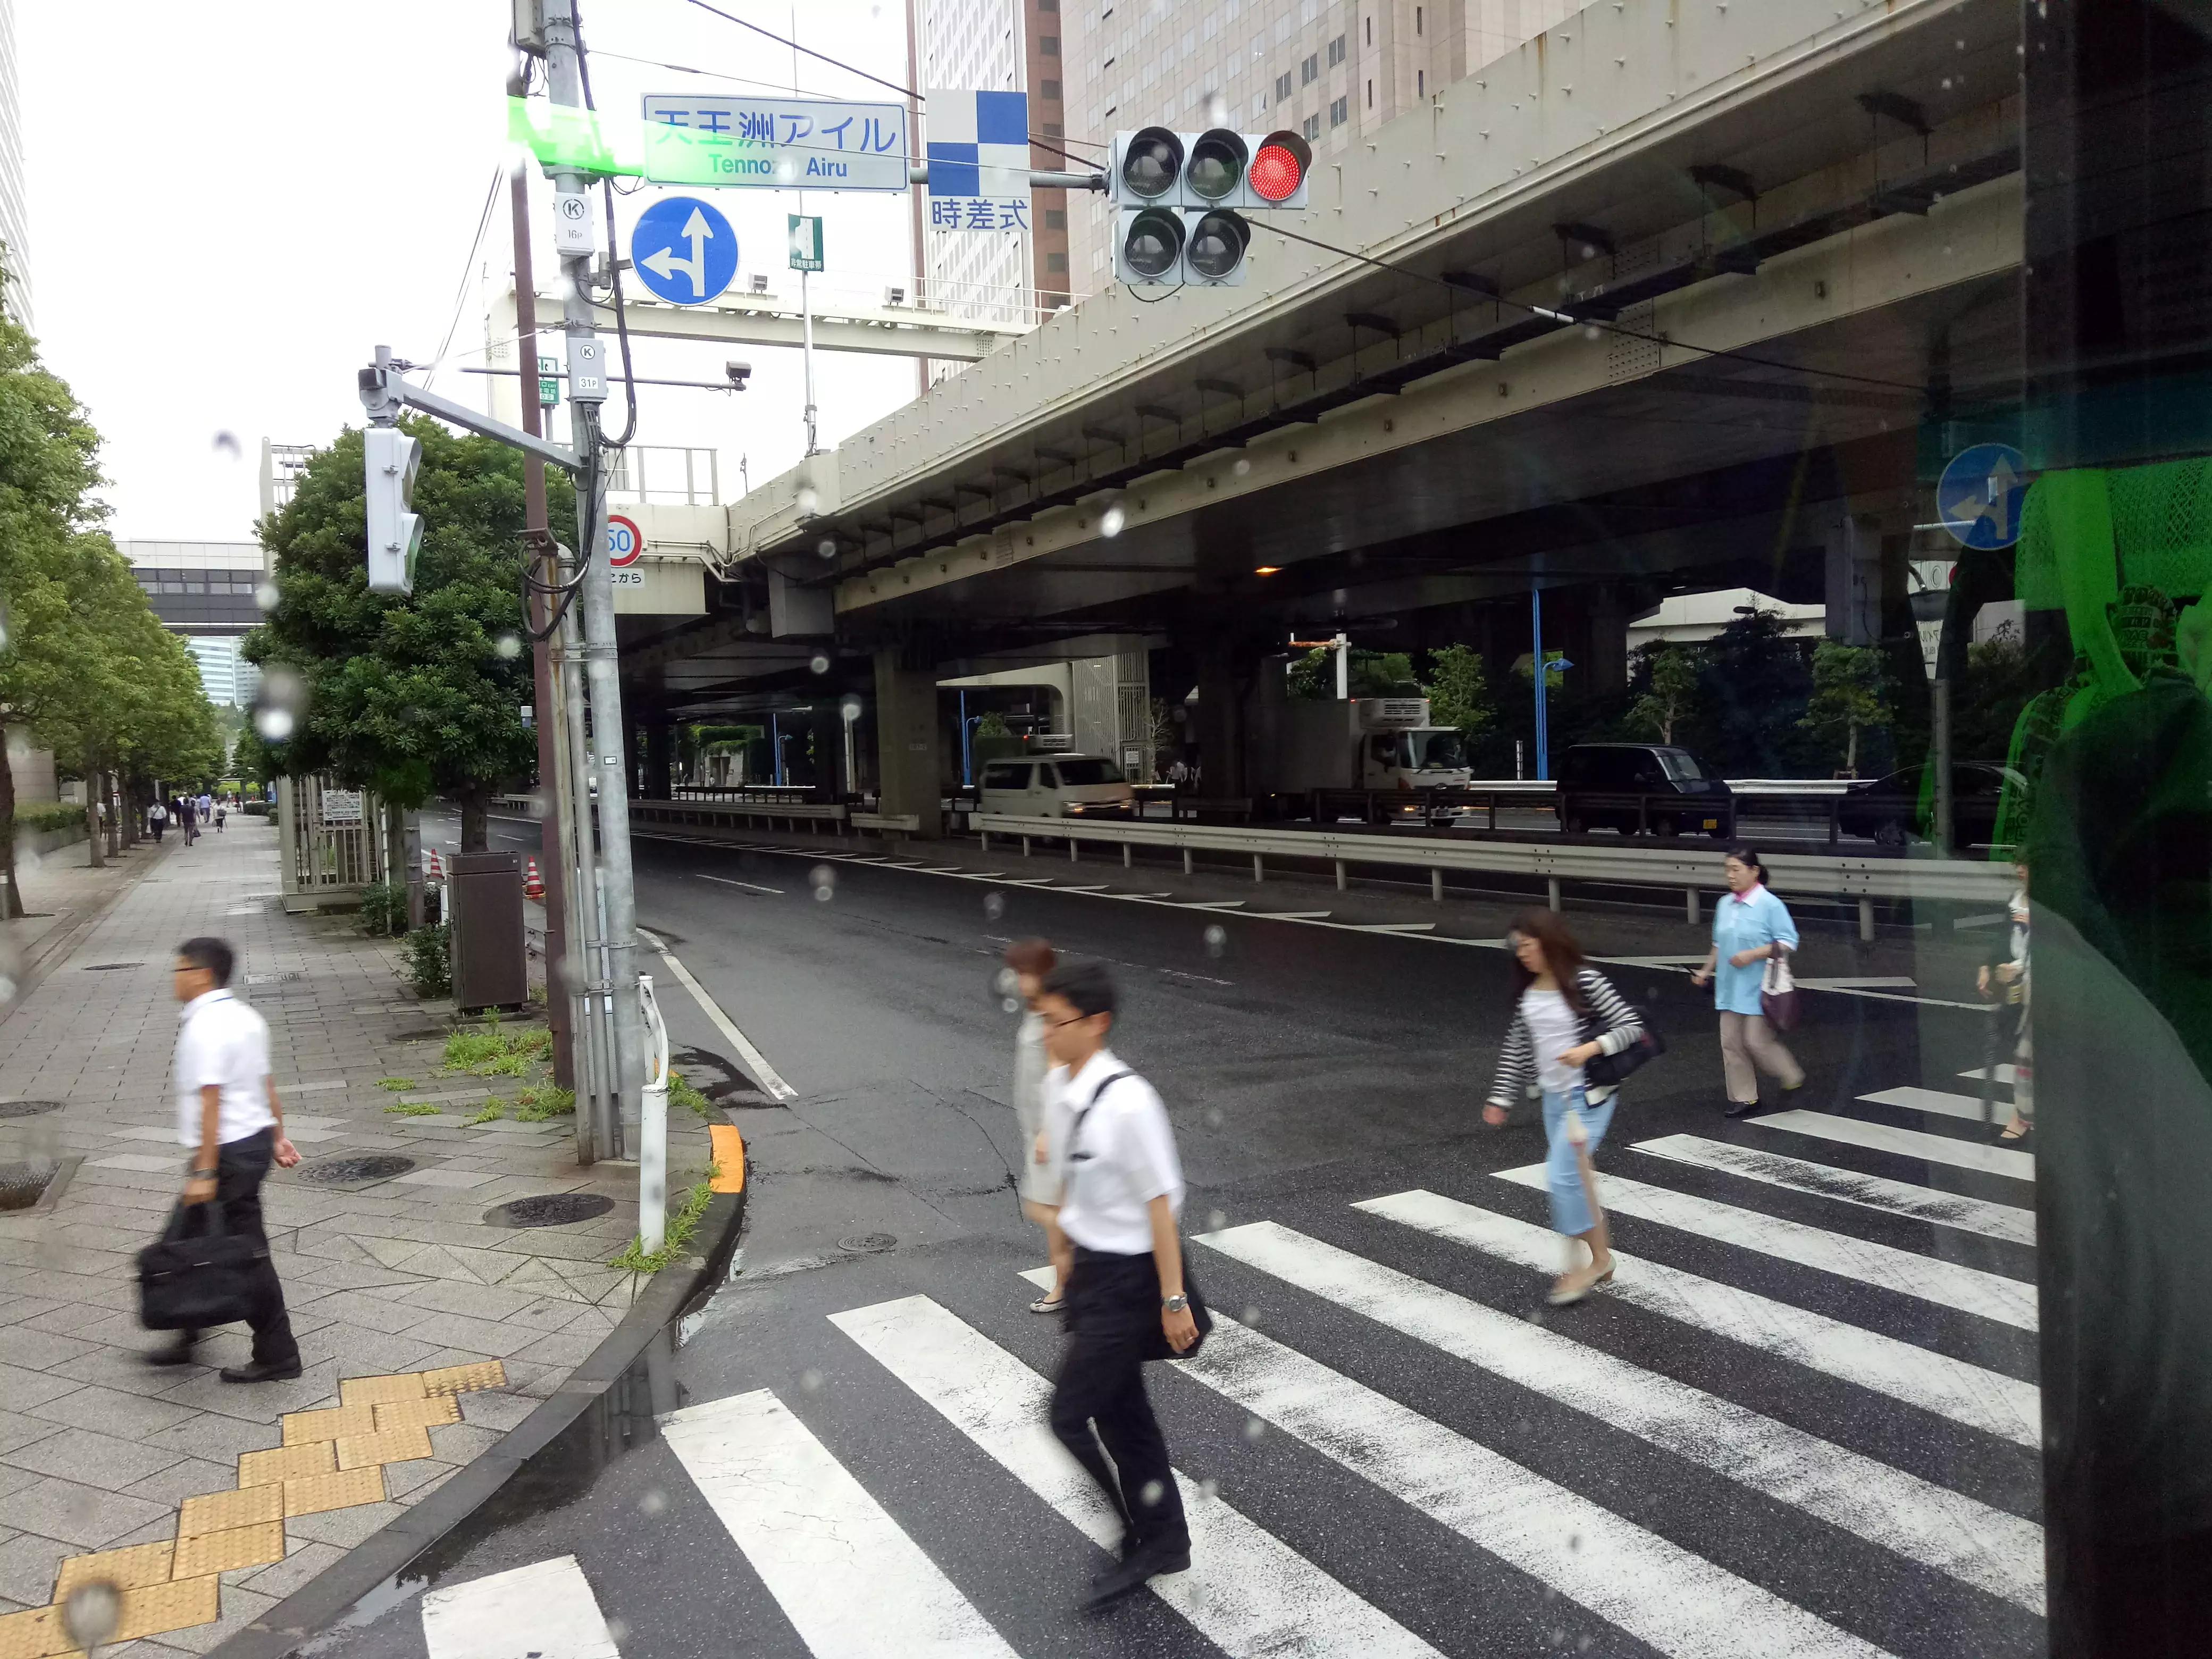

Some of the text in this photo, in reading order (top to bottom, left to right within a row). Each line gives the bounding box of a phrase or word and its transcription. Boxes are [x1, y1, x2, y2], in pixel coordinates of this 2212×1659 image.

[655, 110, 895, 152] 天王洲アイル
[708, 154, 847, 177] Tenno Airu
[932, 198, 1028, 230] 時差式
[791, 258, 822, 269] 非常駐車帯
[608, 529, 630, 552] 50
